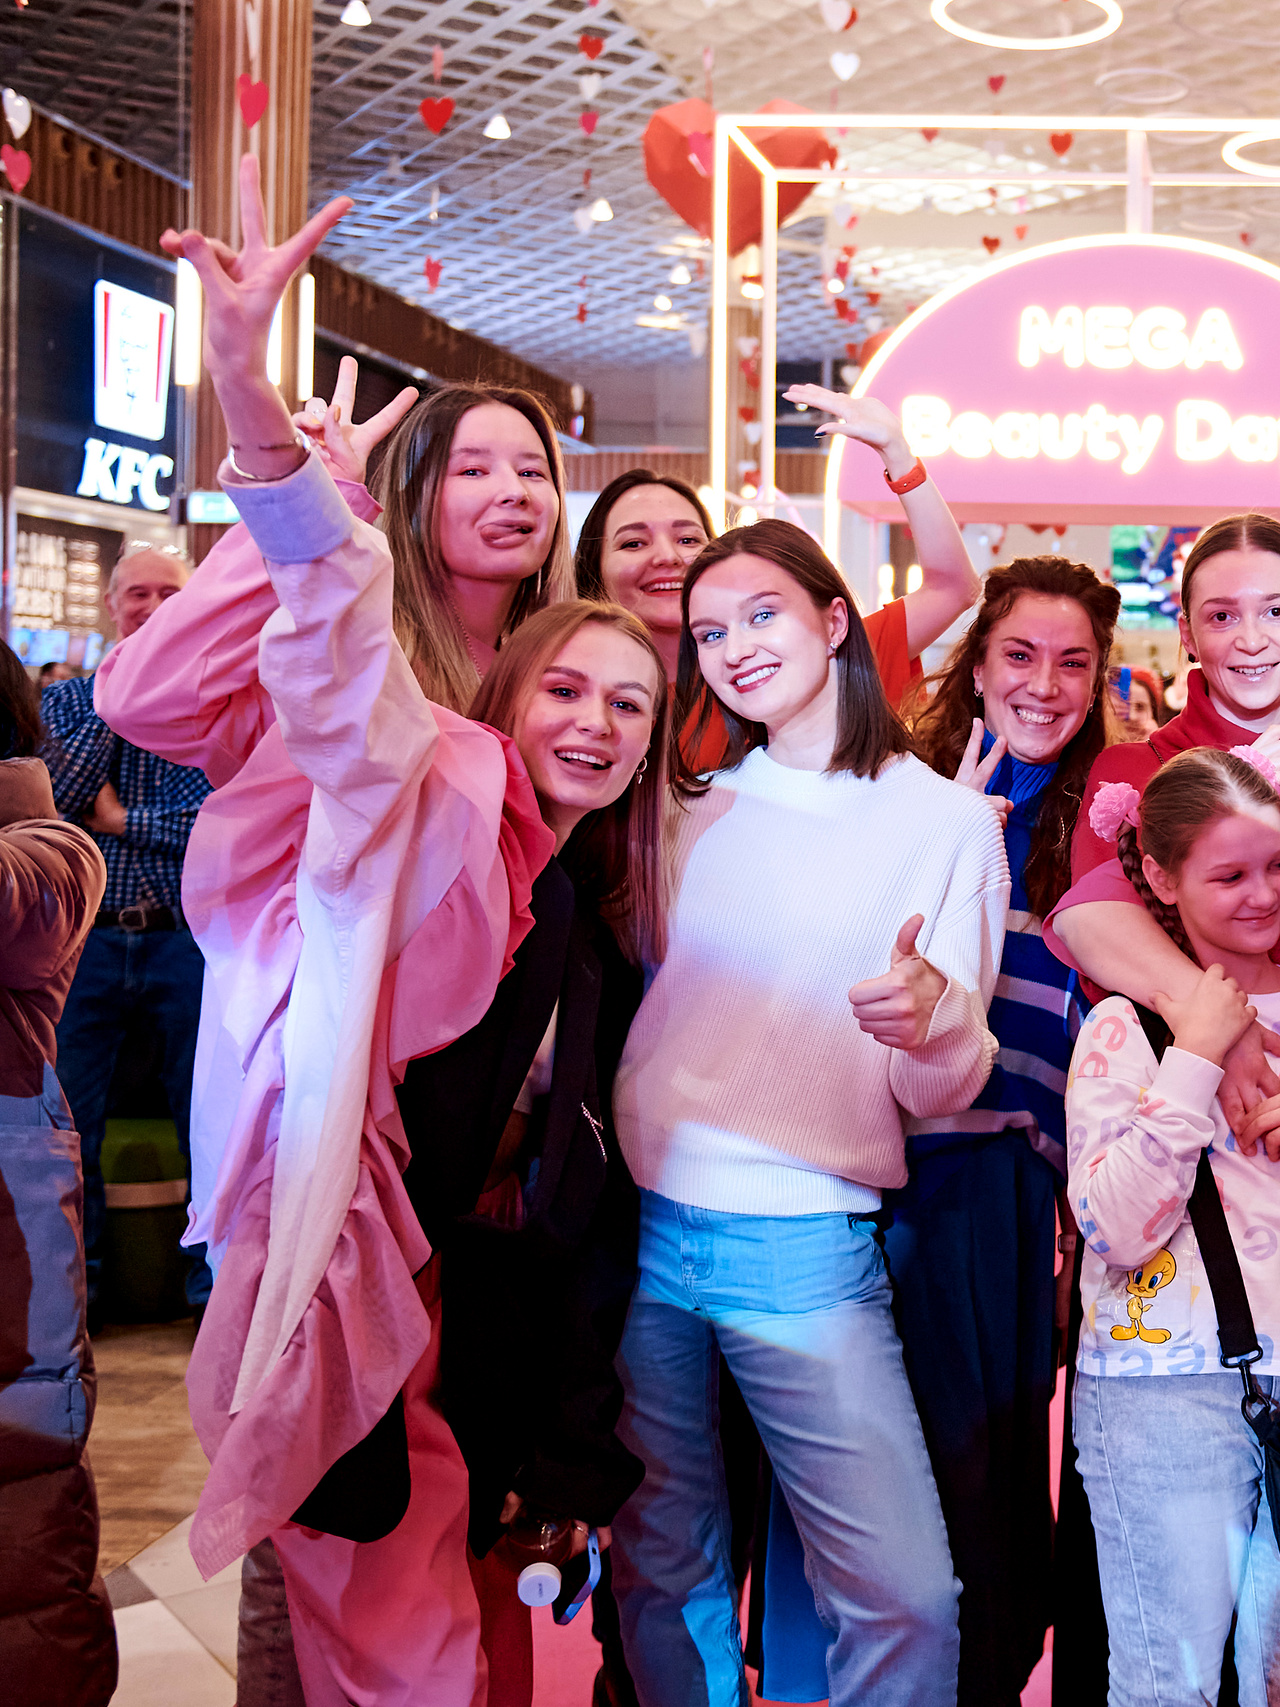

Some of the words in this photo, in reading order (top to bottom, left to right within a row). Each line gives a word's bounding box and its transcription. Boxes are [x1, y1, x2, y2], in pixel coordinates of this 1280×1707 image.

[1018, 305, 1244, 371] MEGA
[901, 396, 1164, 475] Beauty
[77, 437, 175, 511] KFC
